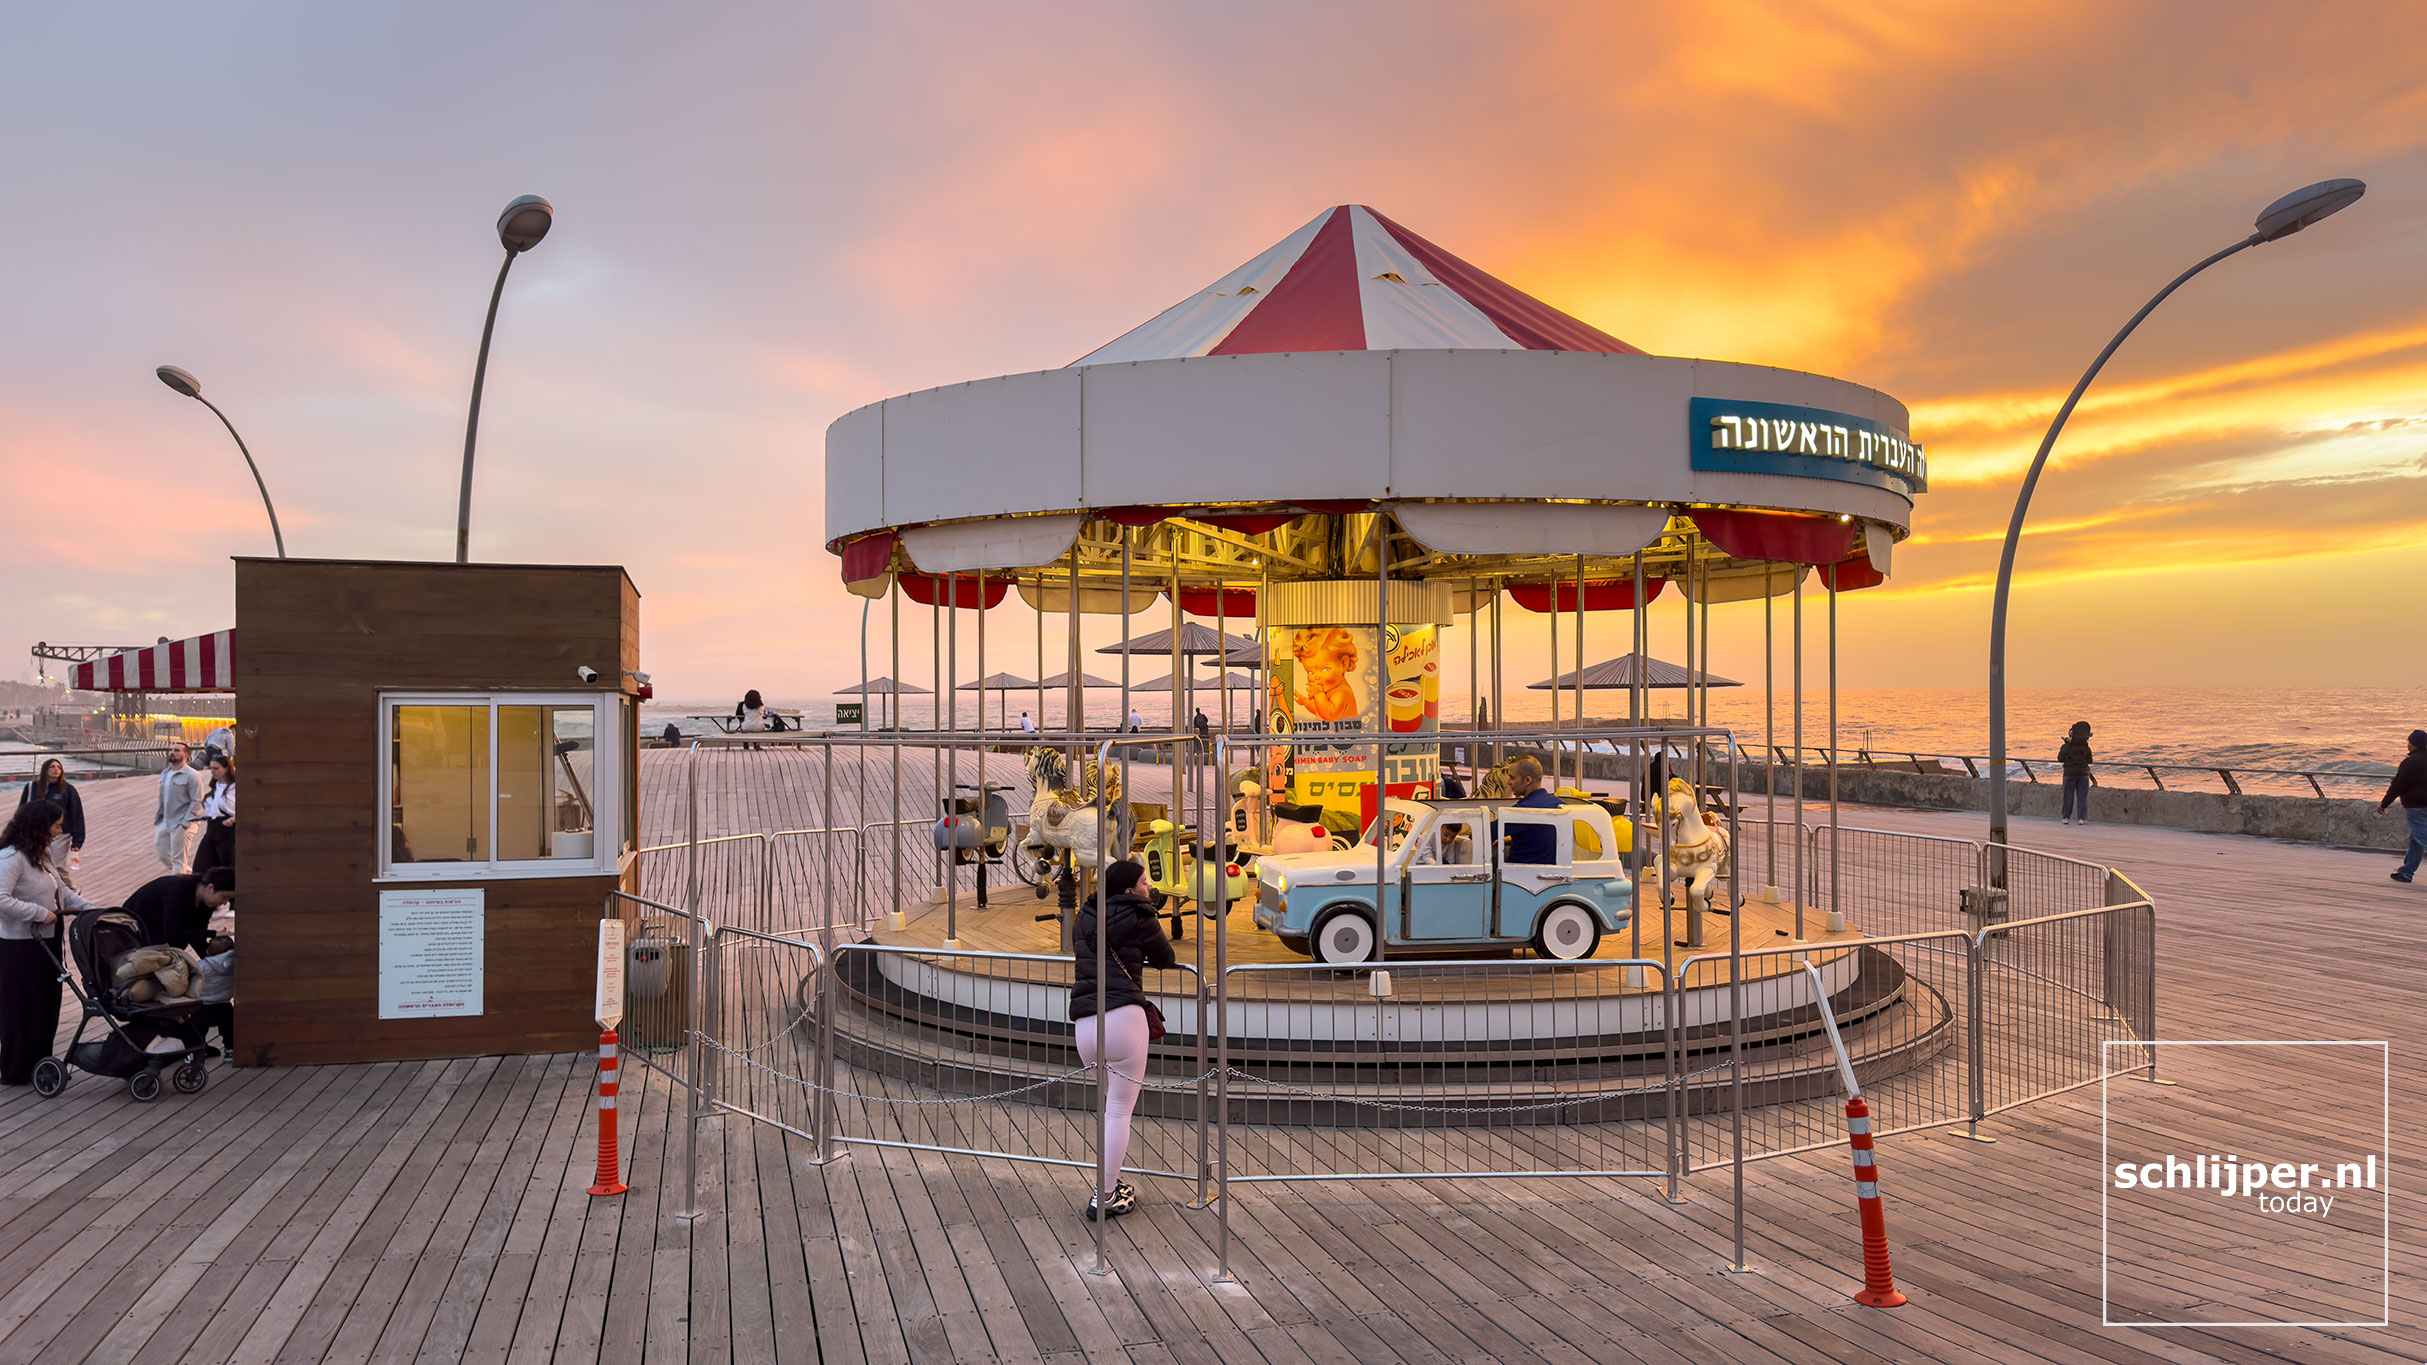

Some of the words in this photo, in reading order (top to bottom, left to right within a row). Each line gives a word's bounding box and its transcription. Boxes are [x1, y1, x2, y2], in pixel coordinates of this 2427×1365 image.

[1719, 415, 1848, 457] הראשונה
[1859, 429, 1914, 474] העברית
[837, 709, 860, 718] יציאה
[1334, 720, 1362, 732] סבון
[1317, 756, 1340, 764] BABY
[1342, 755, 1368, 763] SOAP
